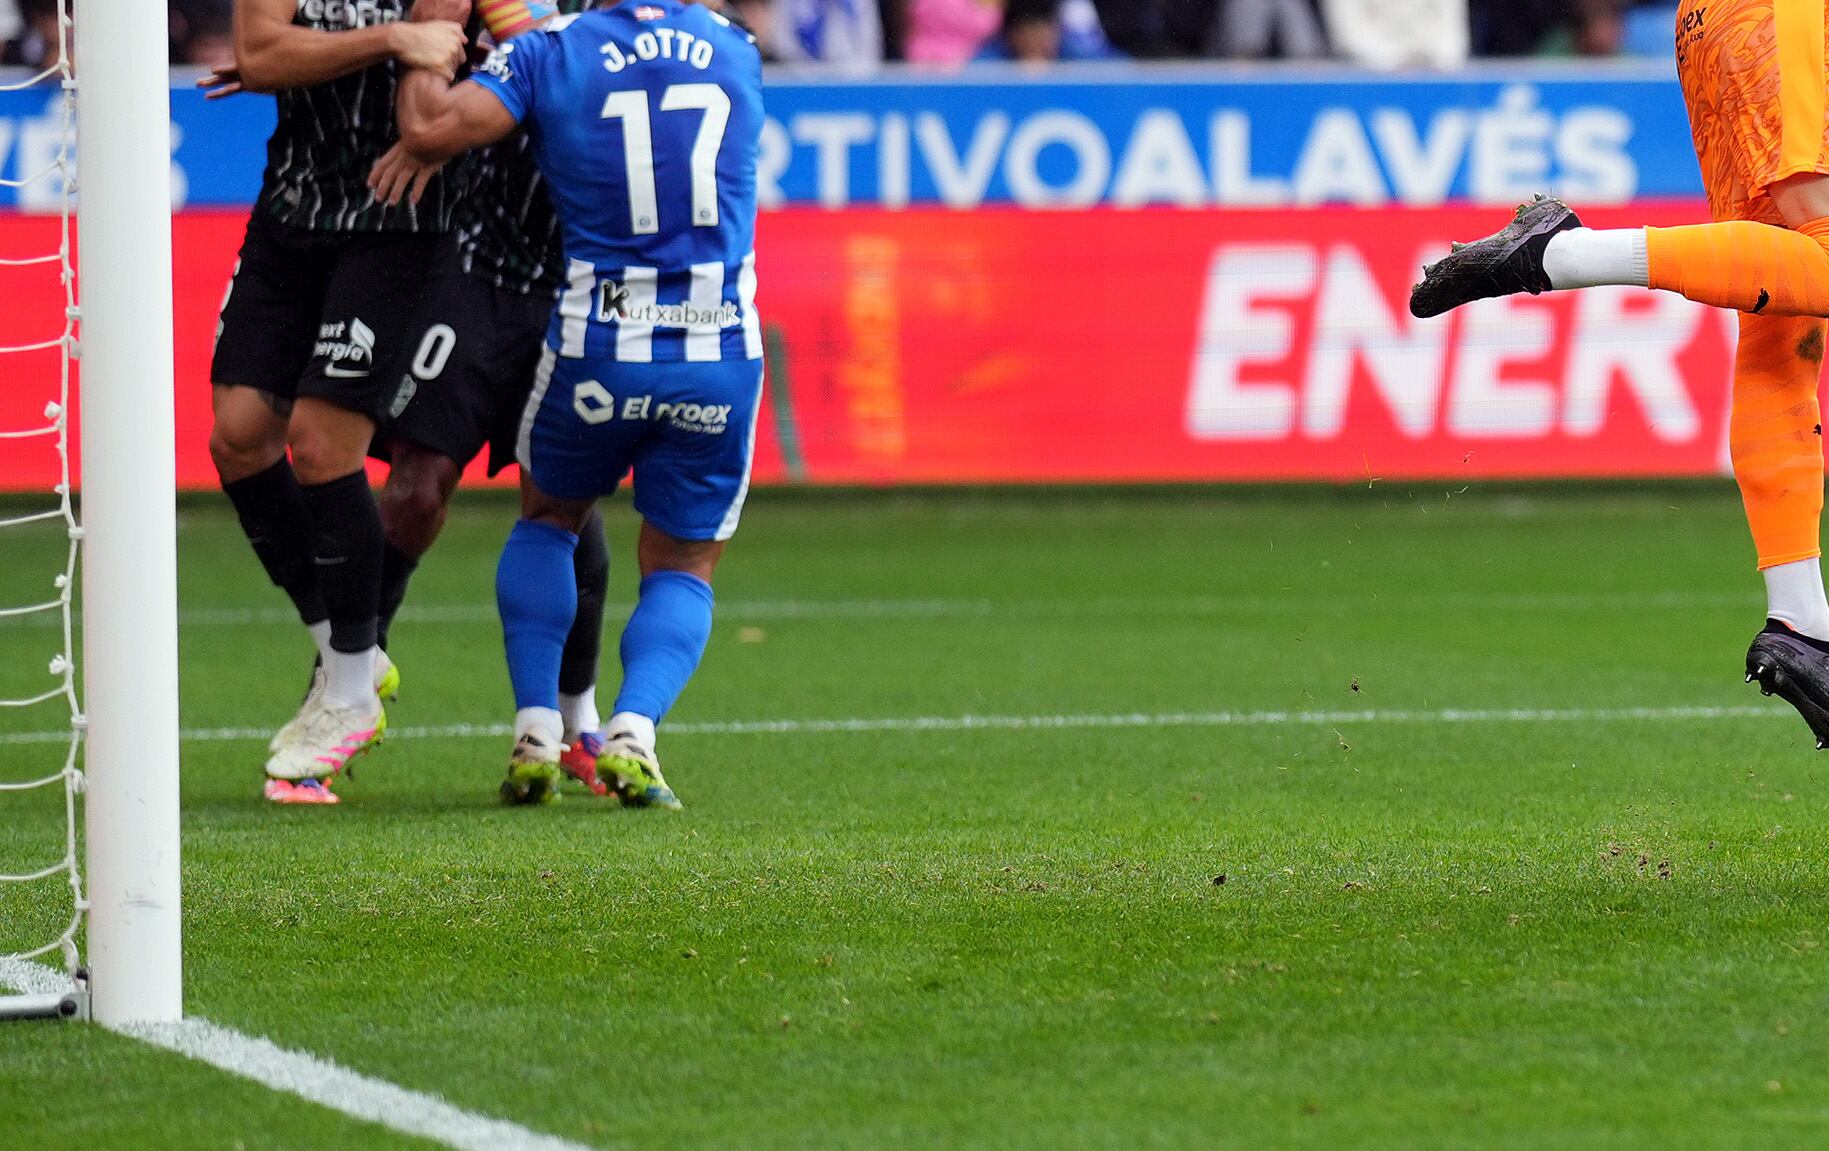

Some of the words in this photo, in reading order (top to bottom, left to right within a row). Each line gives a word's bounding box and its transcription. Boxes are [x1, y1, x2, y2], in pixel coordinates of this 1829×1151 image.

[600, 28, 714, 74] J.OTTO
[601, 82, 732, 235] 17
[598, 280, 741, 328] Kutxabank
[622, 396, 652, 420] El
